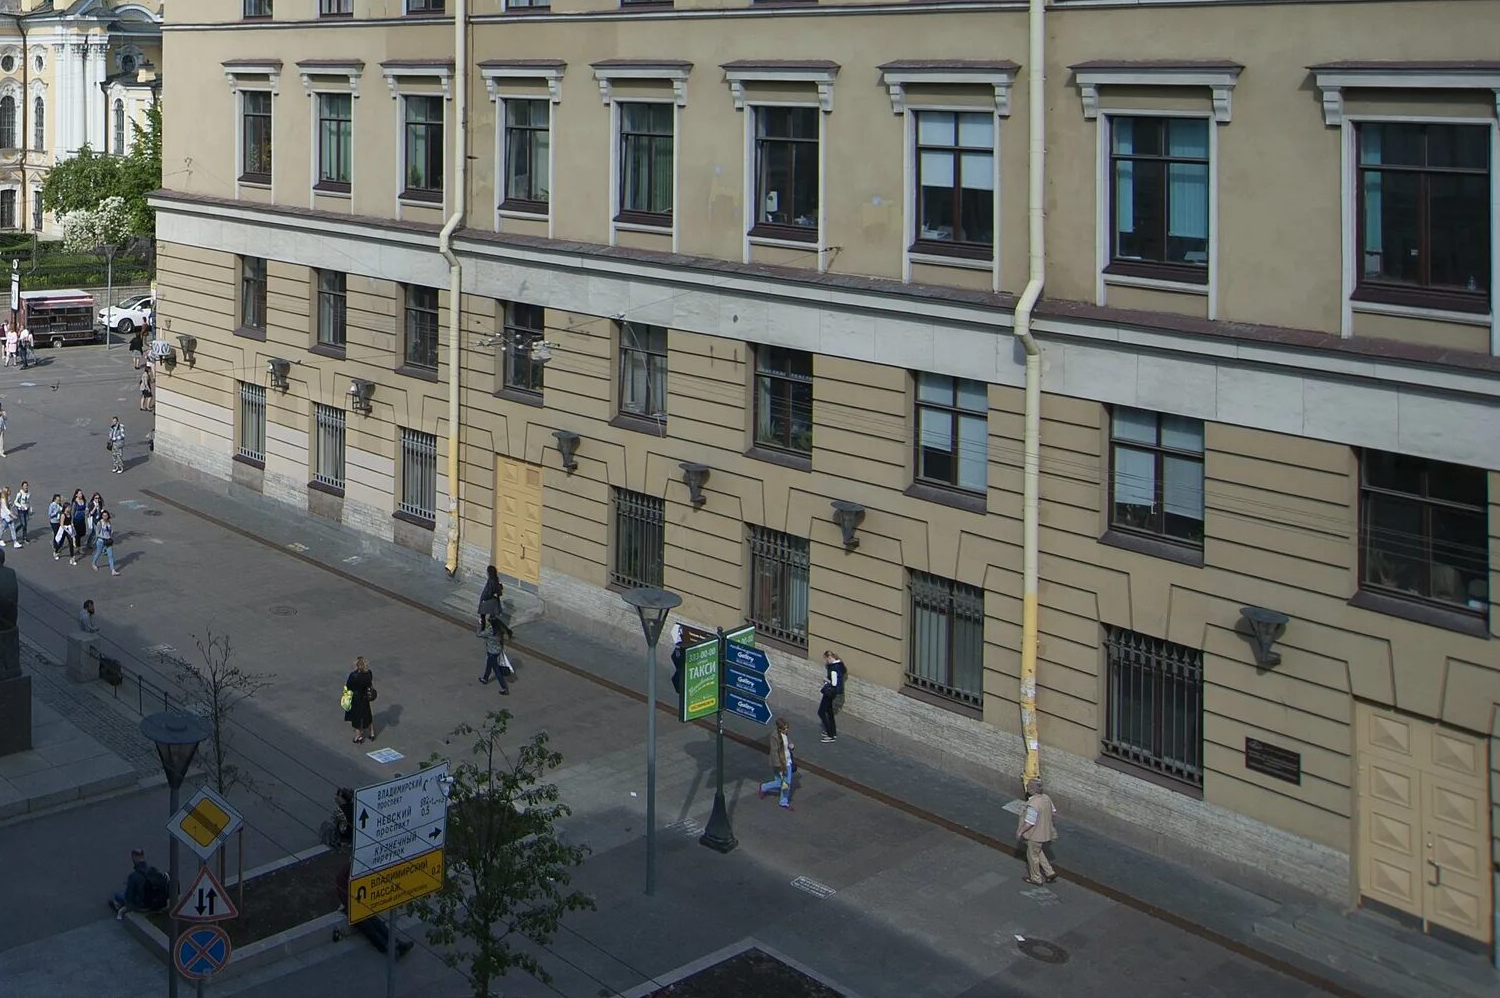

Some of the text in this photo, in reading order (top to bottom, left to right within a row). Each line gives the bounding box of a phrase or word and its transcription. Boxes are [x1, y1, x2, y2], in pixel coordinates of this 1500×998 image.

[737, 651, 754, 663] Gallery
[689, 661, 716, 679] ТАКСИ
[737, 676, 754, 688] Gallery
[737, 700, 755, 713] Gallery
[377, 777, 422, 800] ВЛАДИМИРСКИЙ
[377, 796, 402, 810] проспект
[376, 805, 411, 827] НЕВСКИЙ
[375, 819, 409, 839] проспект
[374, 831, 418, 856] КУЗНЕЧНЫЙ
[371, 848, 404, 866] переулок
[370, 860, 428, 888] ВЛАДИМИРСКИЙ
[370, 883, 401, 900] ПАССАЖ
